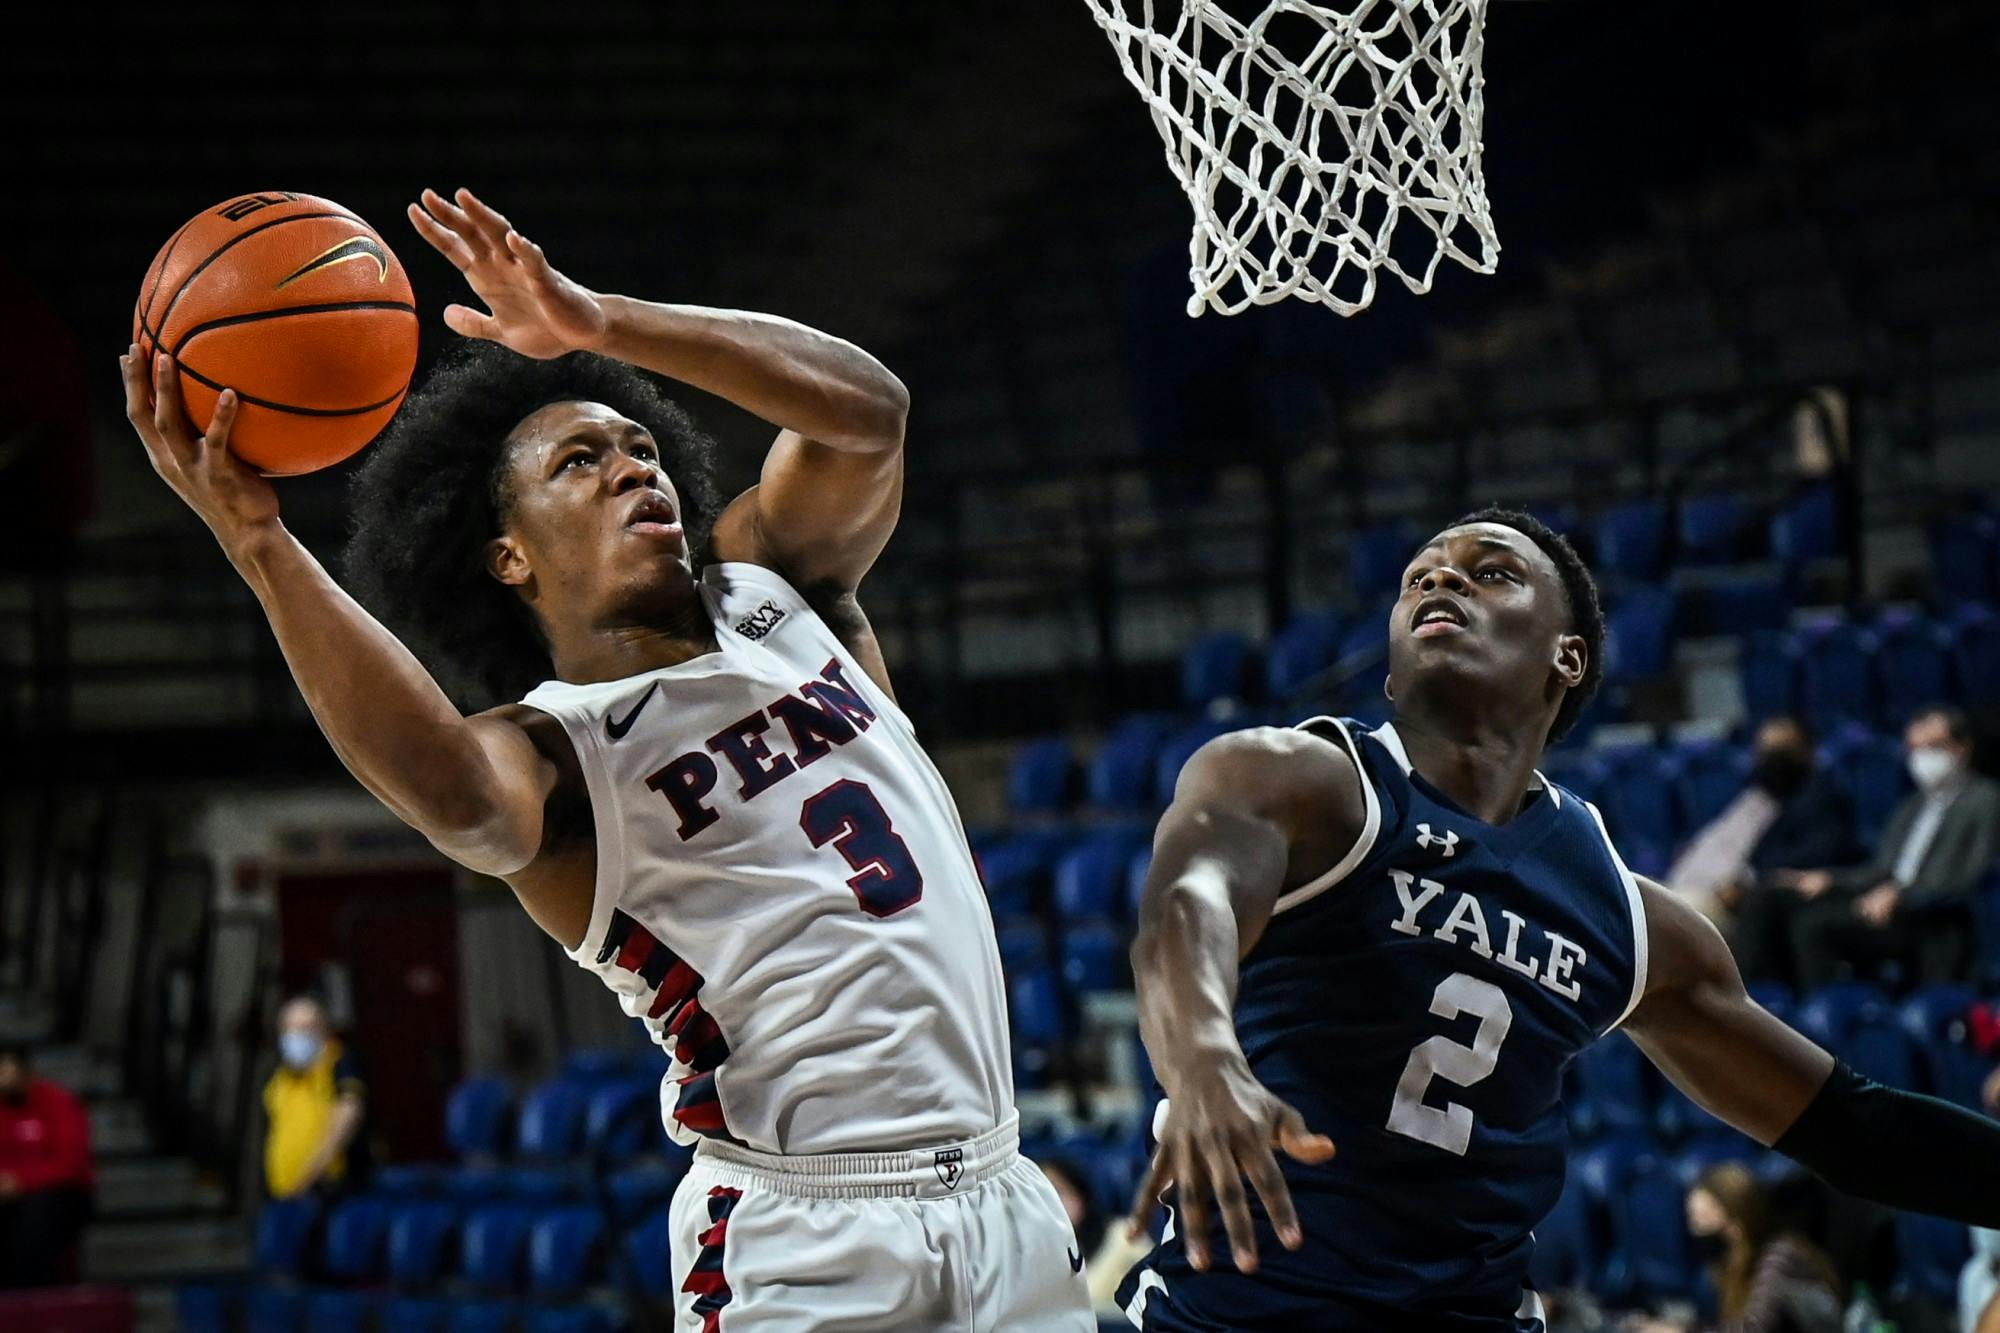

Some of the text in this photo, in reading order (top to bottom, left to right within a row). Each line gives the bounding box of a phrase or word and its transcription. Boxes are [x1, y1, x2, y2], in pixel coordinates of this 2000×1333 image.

[749, 600, 778, 632] IVY
[645, 657, 877, 841] PENN
[799, 778, 923, 918] 3
[1388, 868, 1587, 1001] YALE
[1386, 972, 1512, 1156] 2
[944, 1164, 958, 1182] P
